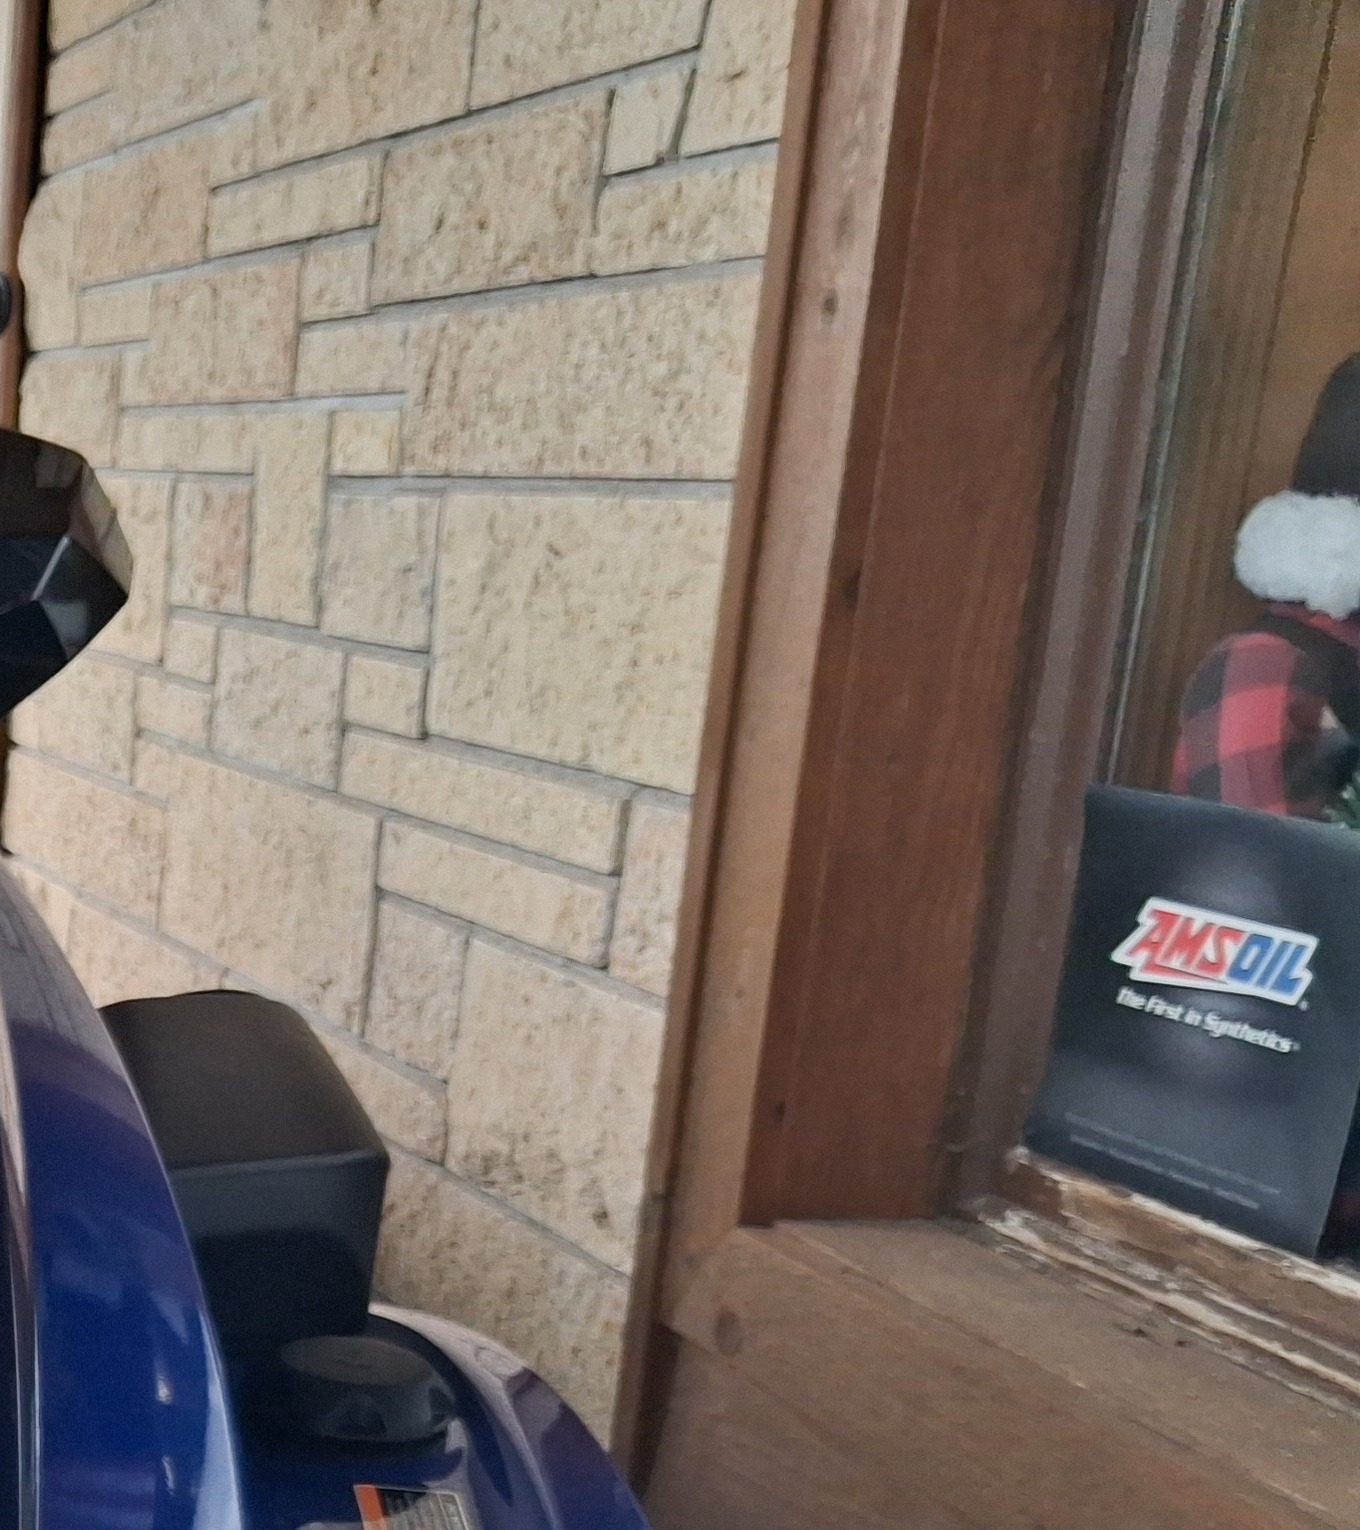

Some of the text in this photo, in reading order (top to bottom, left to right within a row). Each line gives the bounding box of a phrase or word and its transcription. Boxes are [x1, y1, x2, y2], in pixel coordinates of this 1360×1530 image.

[1126, 908, 1310, 998] AMSOIL
[1145, 995, 1184, 1022] First
[1184, 1008, 1203, 1027] in
